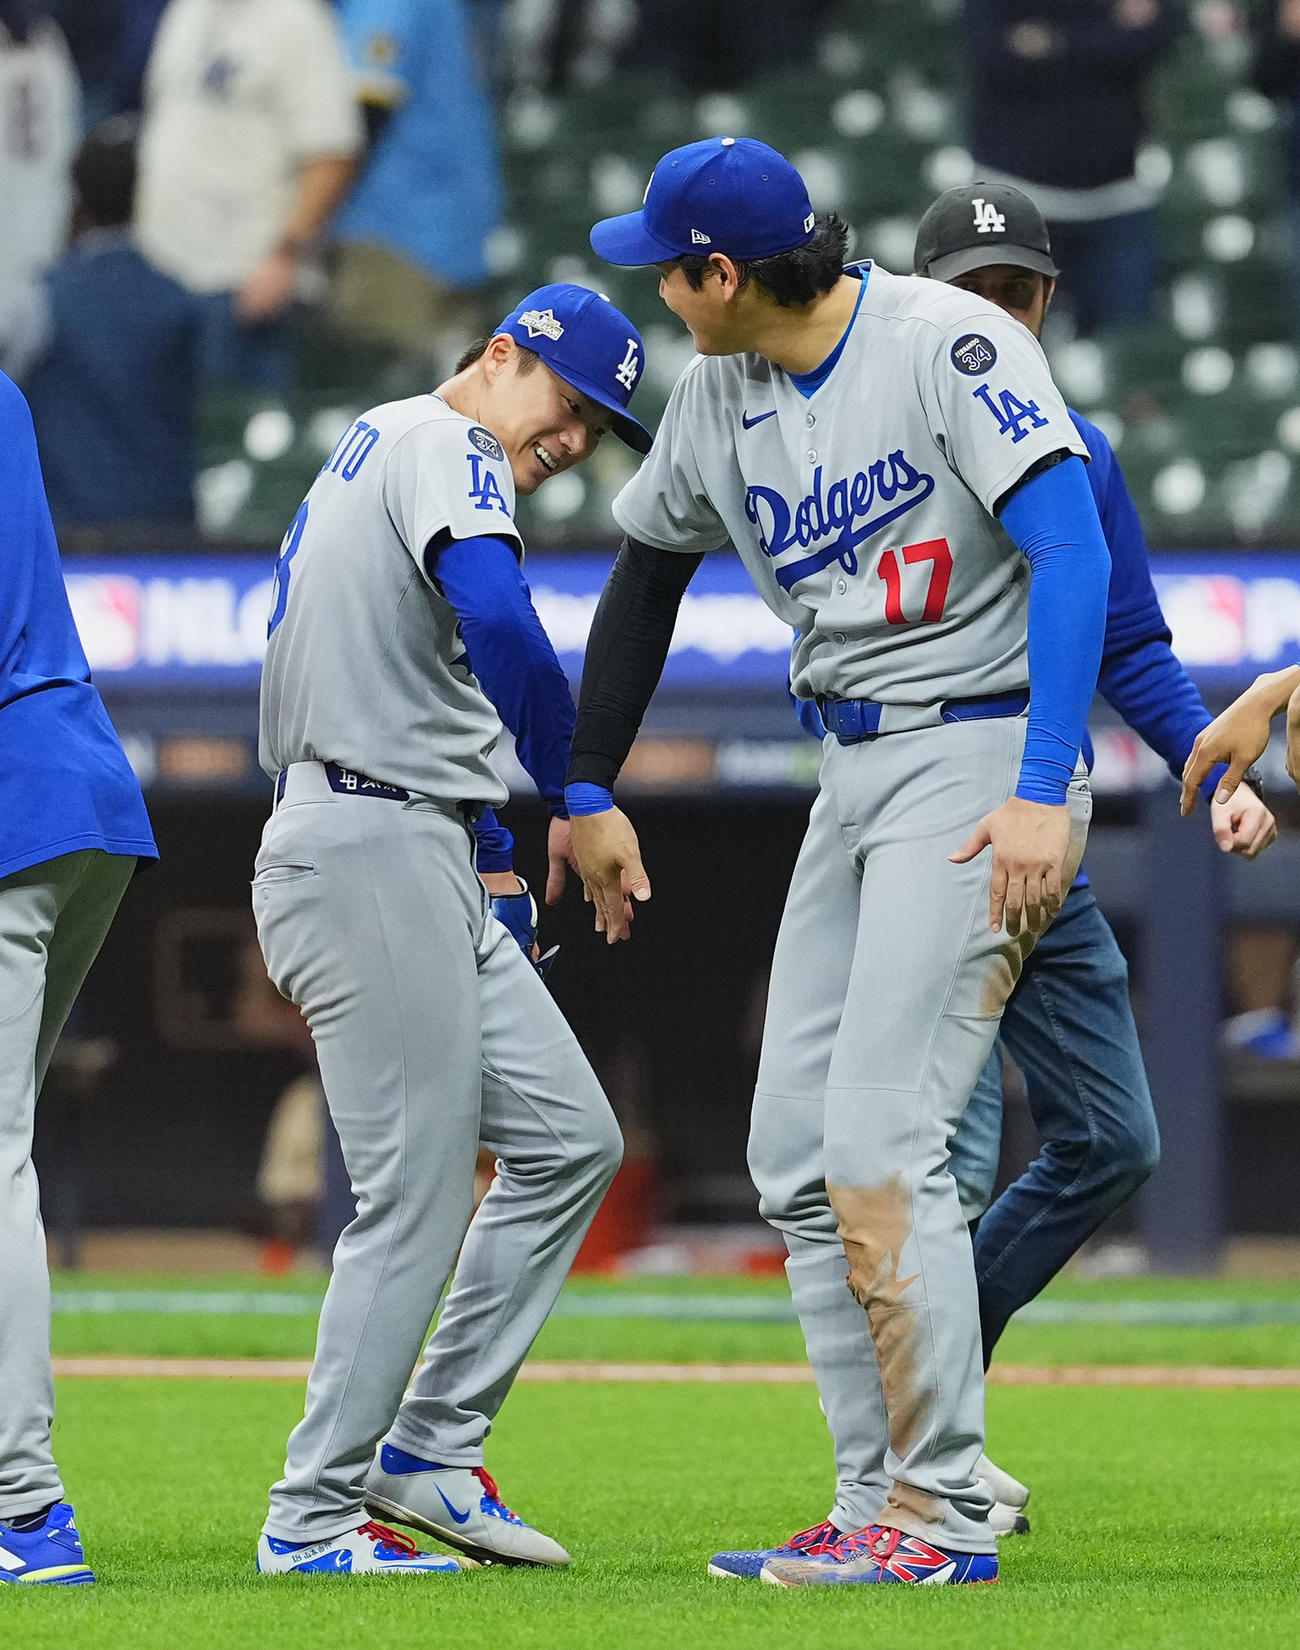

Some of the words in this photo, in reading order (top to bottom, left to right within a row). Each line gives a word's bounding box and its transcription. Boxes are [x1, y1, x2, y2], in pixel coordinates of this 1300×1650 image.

[972, 199, 1006, 233] LA
[614, 338, 638, 391] LA
[954, 337, 980, 359] FERNANDO
[962, 344, 992, 371] 34
[972, 383, 1049, 444] LA
[324, 420, 380, 482] TO
[466, 454, 511, 518] LA
[745, 449, 935, 590] Dodgers
[877, 537, 953, 625] 17
